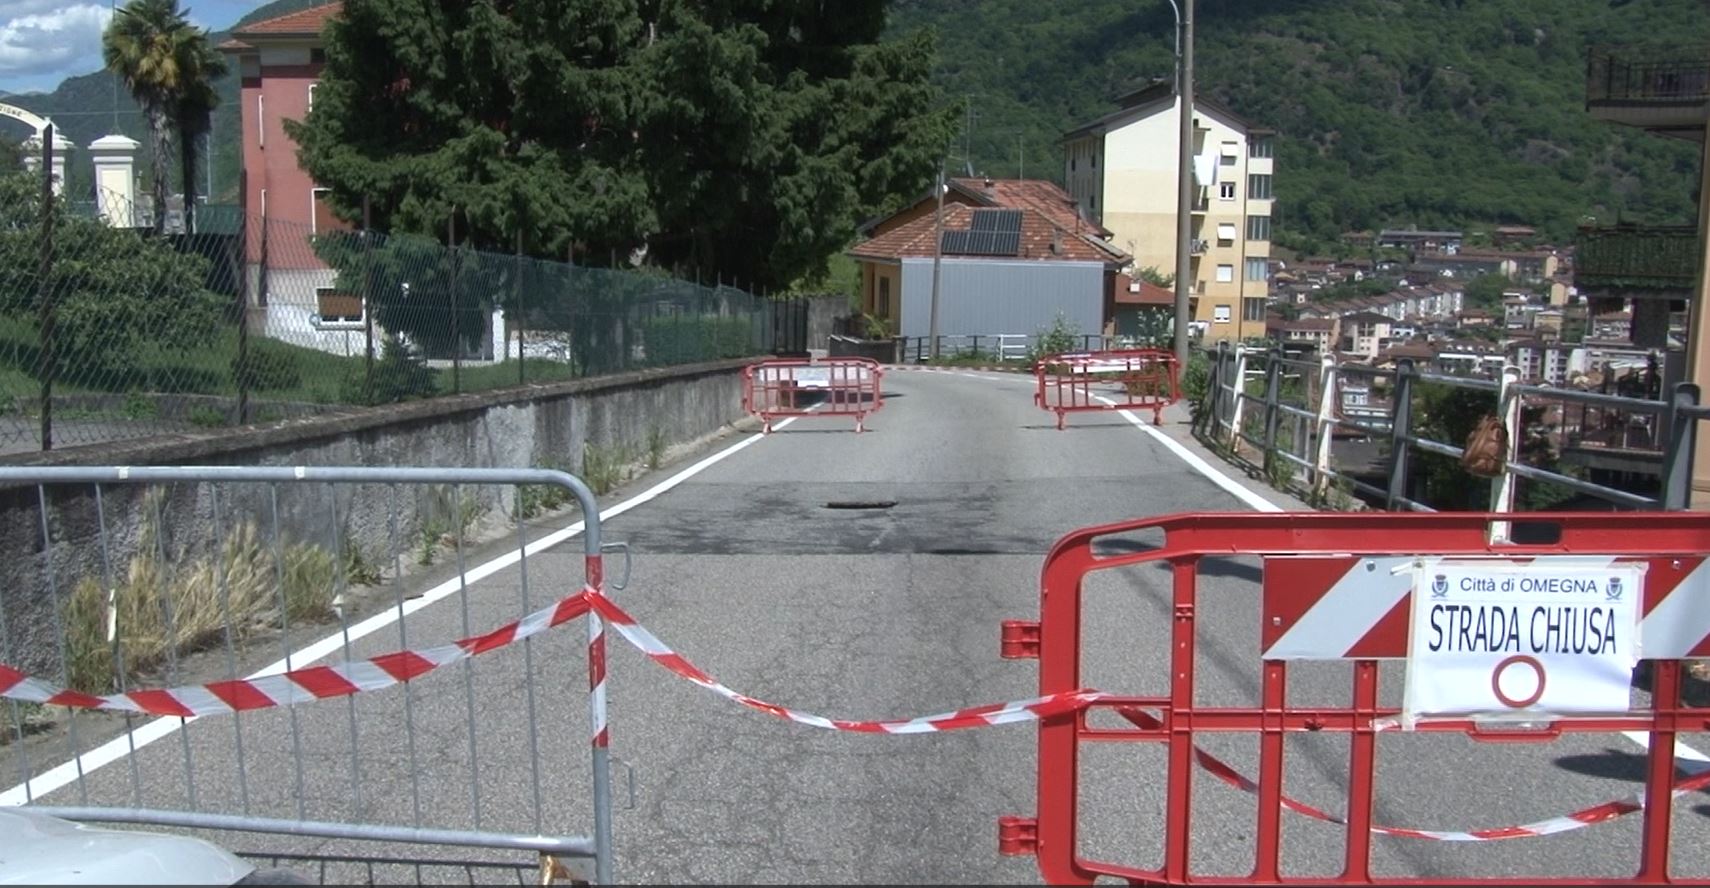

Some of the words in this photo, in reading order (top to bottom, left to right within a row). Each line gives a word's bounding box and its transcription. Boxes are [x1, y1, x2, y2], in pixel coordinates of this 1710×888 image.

[1460, 577, 1496, 592] Città
[1501, 578, 1515, 592] di
[1520, 578, 1598, 593] OMEGNA
[1429, 604, 1520, 652] STRADA
[1530, 606, 1616, 655] CHIUSA
